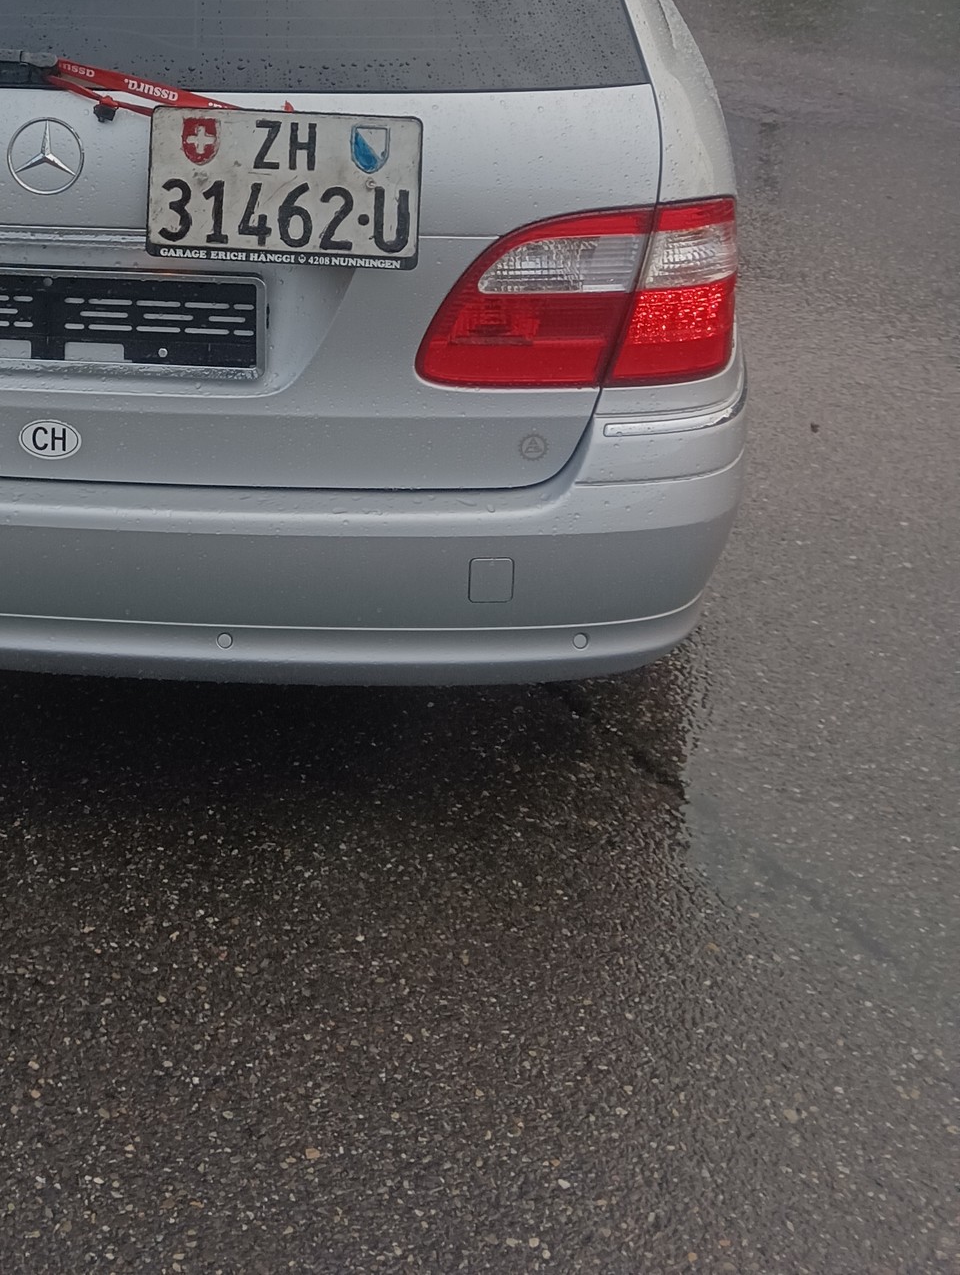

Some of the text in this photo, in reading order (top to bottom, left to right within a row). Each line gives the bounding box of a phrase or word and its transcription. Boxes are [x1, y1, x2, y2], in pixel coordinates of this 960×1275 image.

[253, 119, 318, 171] ZH
[160, 247, 401, 269] GARAGE ERICH HÄNGGI 4208 NUNNINGEN
[32, 426, 67, 452] CH
